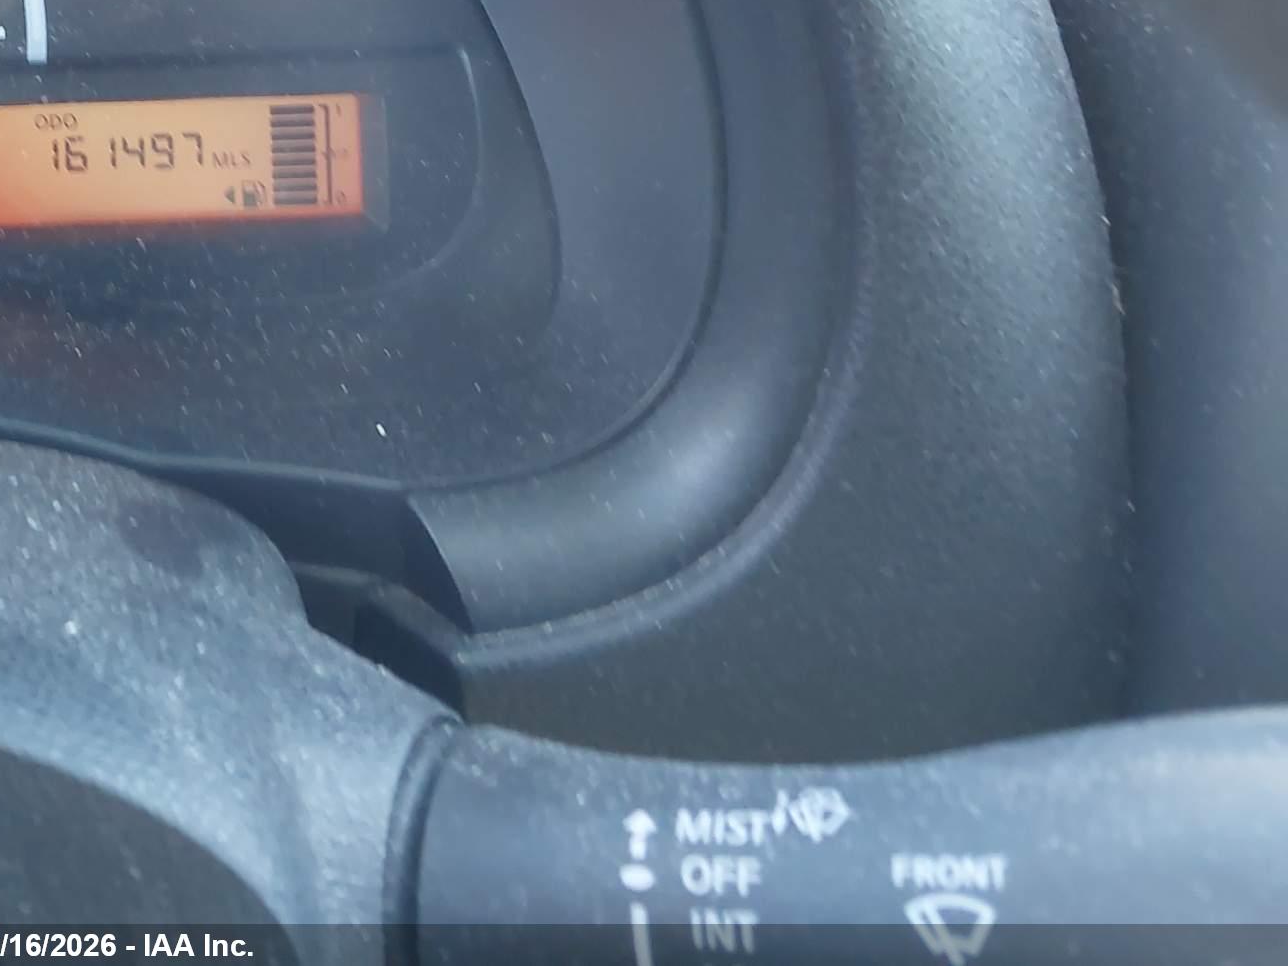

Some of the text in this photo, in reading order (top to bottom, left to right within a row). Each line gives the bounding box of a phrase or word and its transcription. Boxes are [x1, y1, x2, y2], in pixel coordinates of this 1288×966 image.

[34, 113, 79, 131] ODO
[51, 132, 252, 172] 161497 MLS
[675, 808, 770, 846] MIST
[681, 854, 762, 897] OFF
[890, 852, 1009, 892] FRONT
[690, 907, 758, 953] INT
